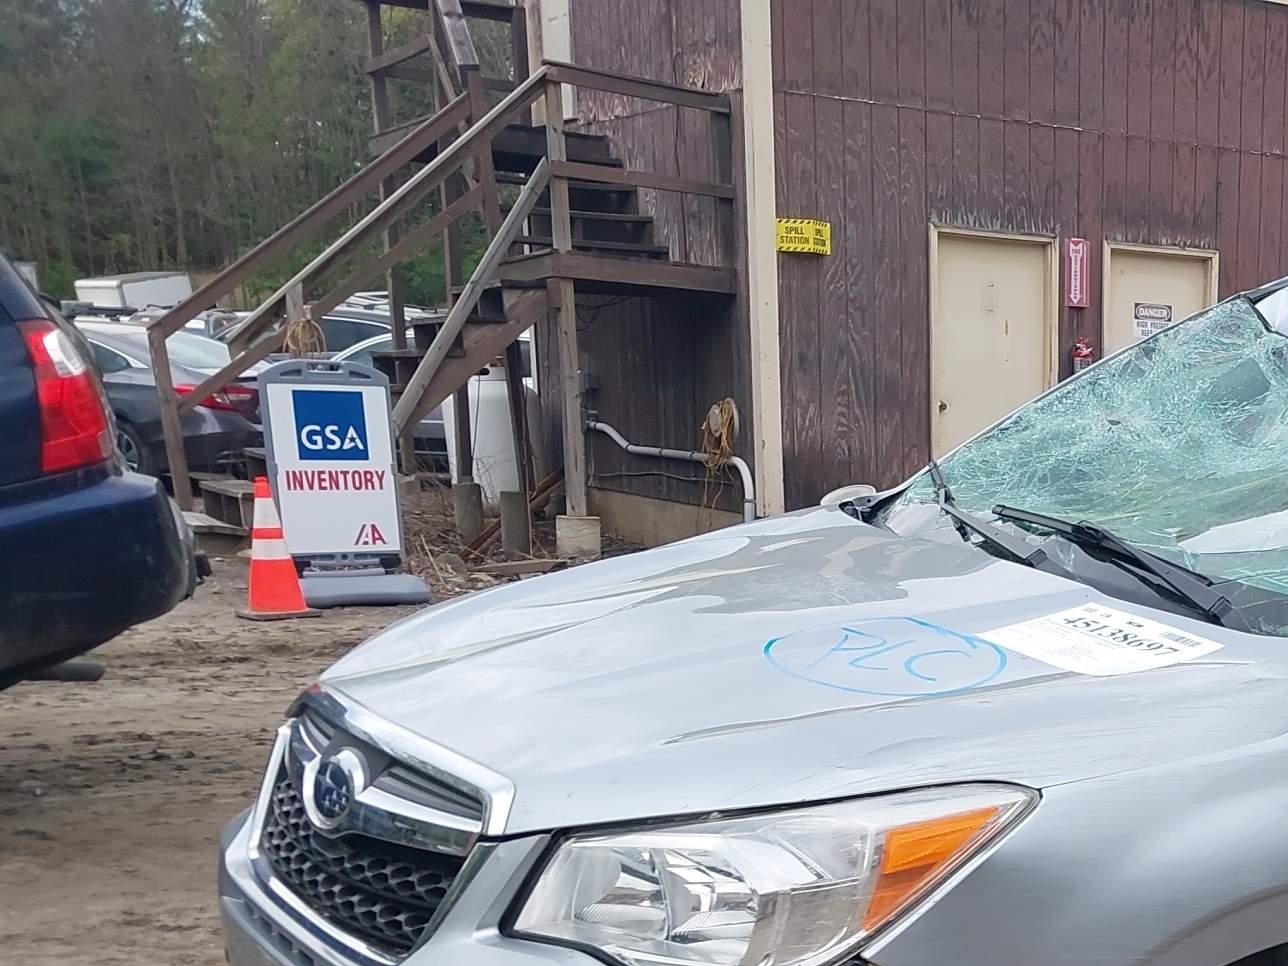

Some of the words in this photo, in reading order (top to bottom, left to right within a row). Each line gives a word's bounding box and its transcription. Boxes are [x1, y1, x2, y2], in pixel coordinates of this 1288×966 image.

[784, 226, 805, 235] SPILL
[780, 235, 810, 244] STATION
[1138, 307, 1168, 318] DANGER
[300, 424, 365, 451] GSA
[285, 469, 386, 492] INVENTORY
[1063, 616, 1180, 657] 45138697
